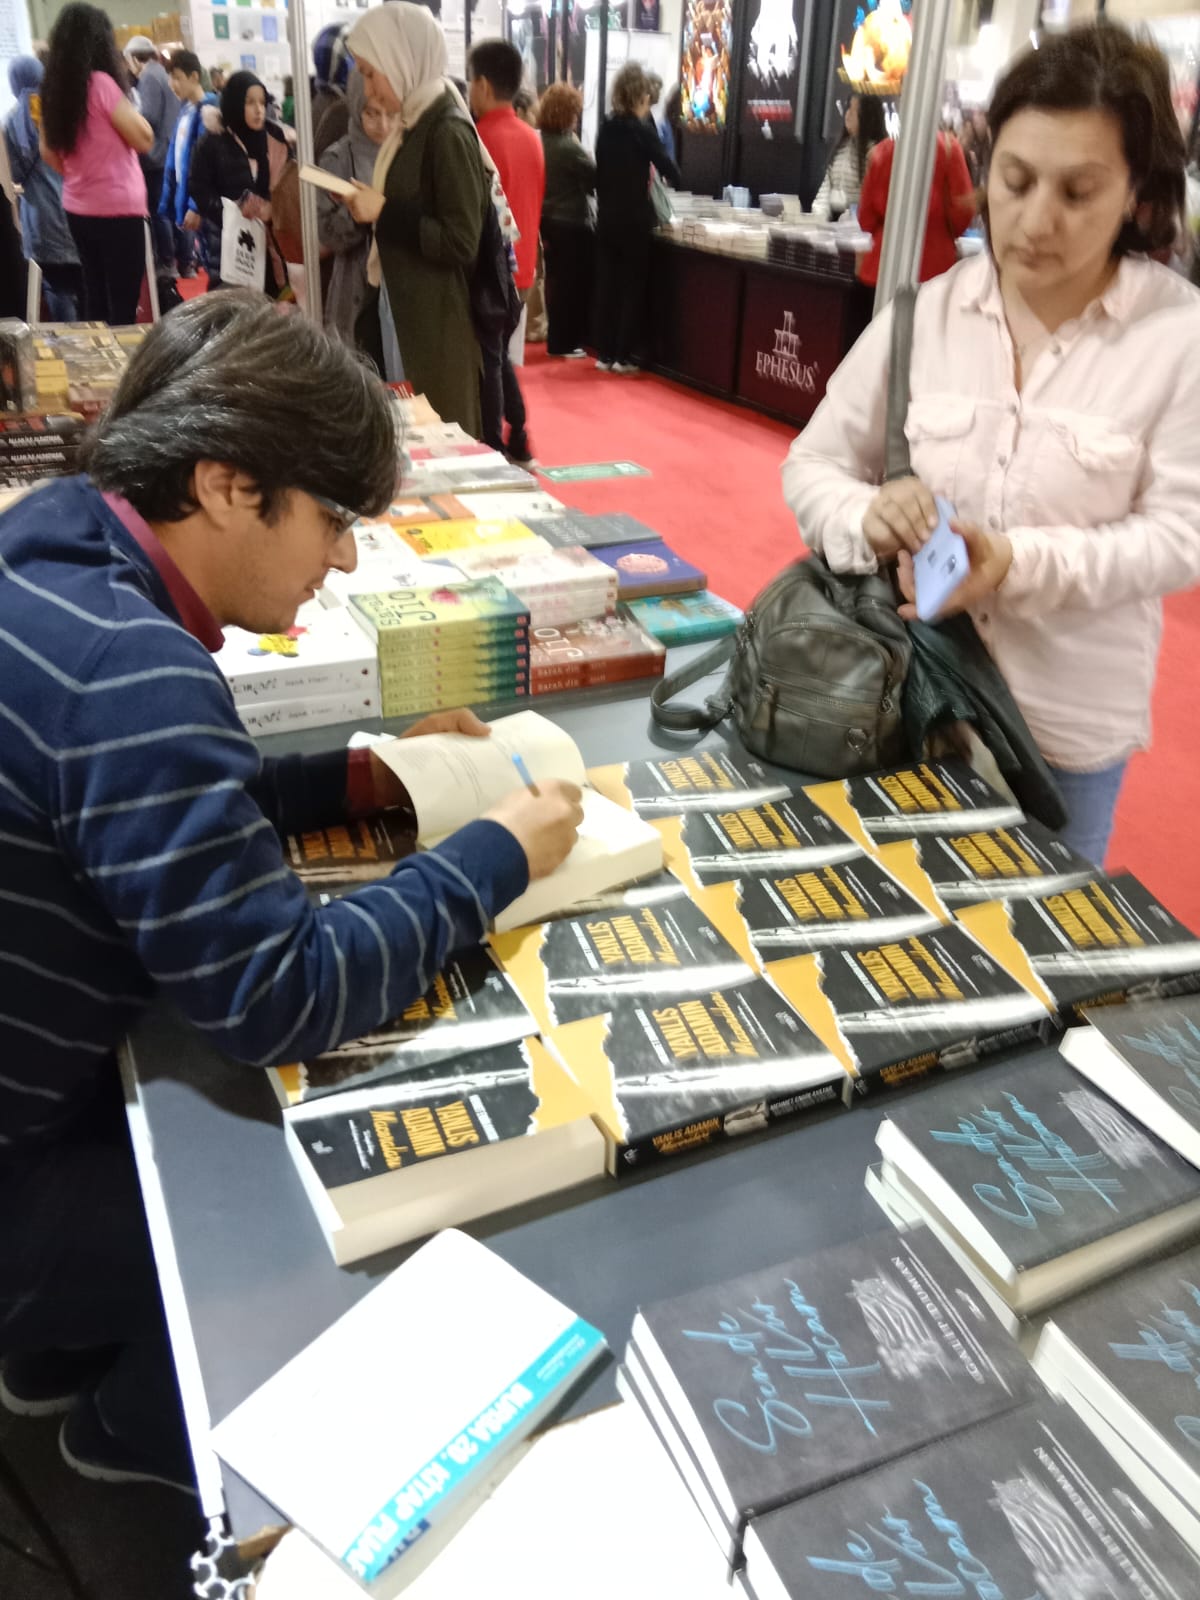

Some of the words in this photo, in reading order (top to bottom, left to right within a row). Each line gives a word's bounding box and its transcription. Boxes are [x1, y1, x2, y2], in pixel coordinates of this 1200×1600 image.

[755, 350, 816, 392] EPHESUS
[609, 914, 656, 963] ADAMIN
[878, 943, 940, 1000] ADAMIN
[677, 999, 731, 1059] ADAMIN
[400, 1106, 447, 1158] ADAMIN
[890, 1255, 944, 1323] DUMAN
